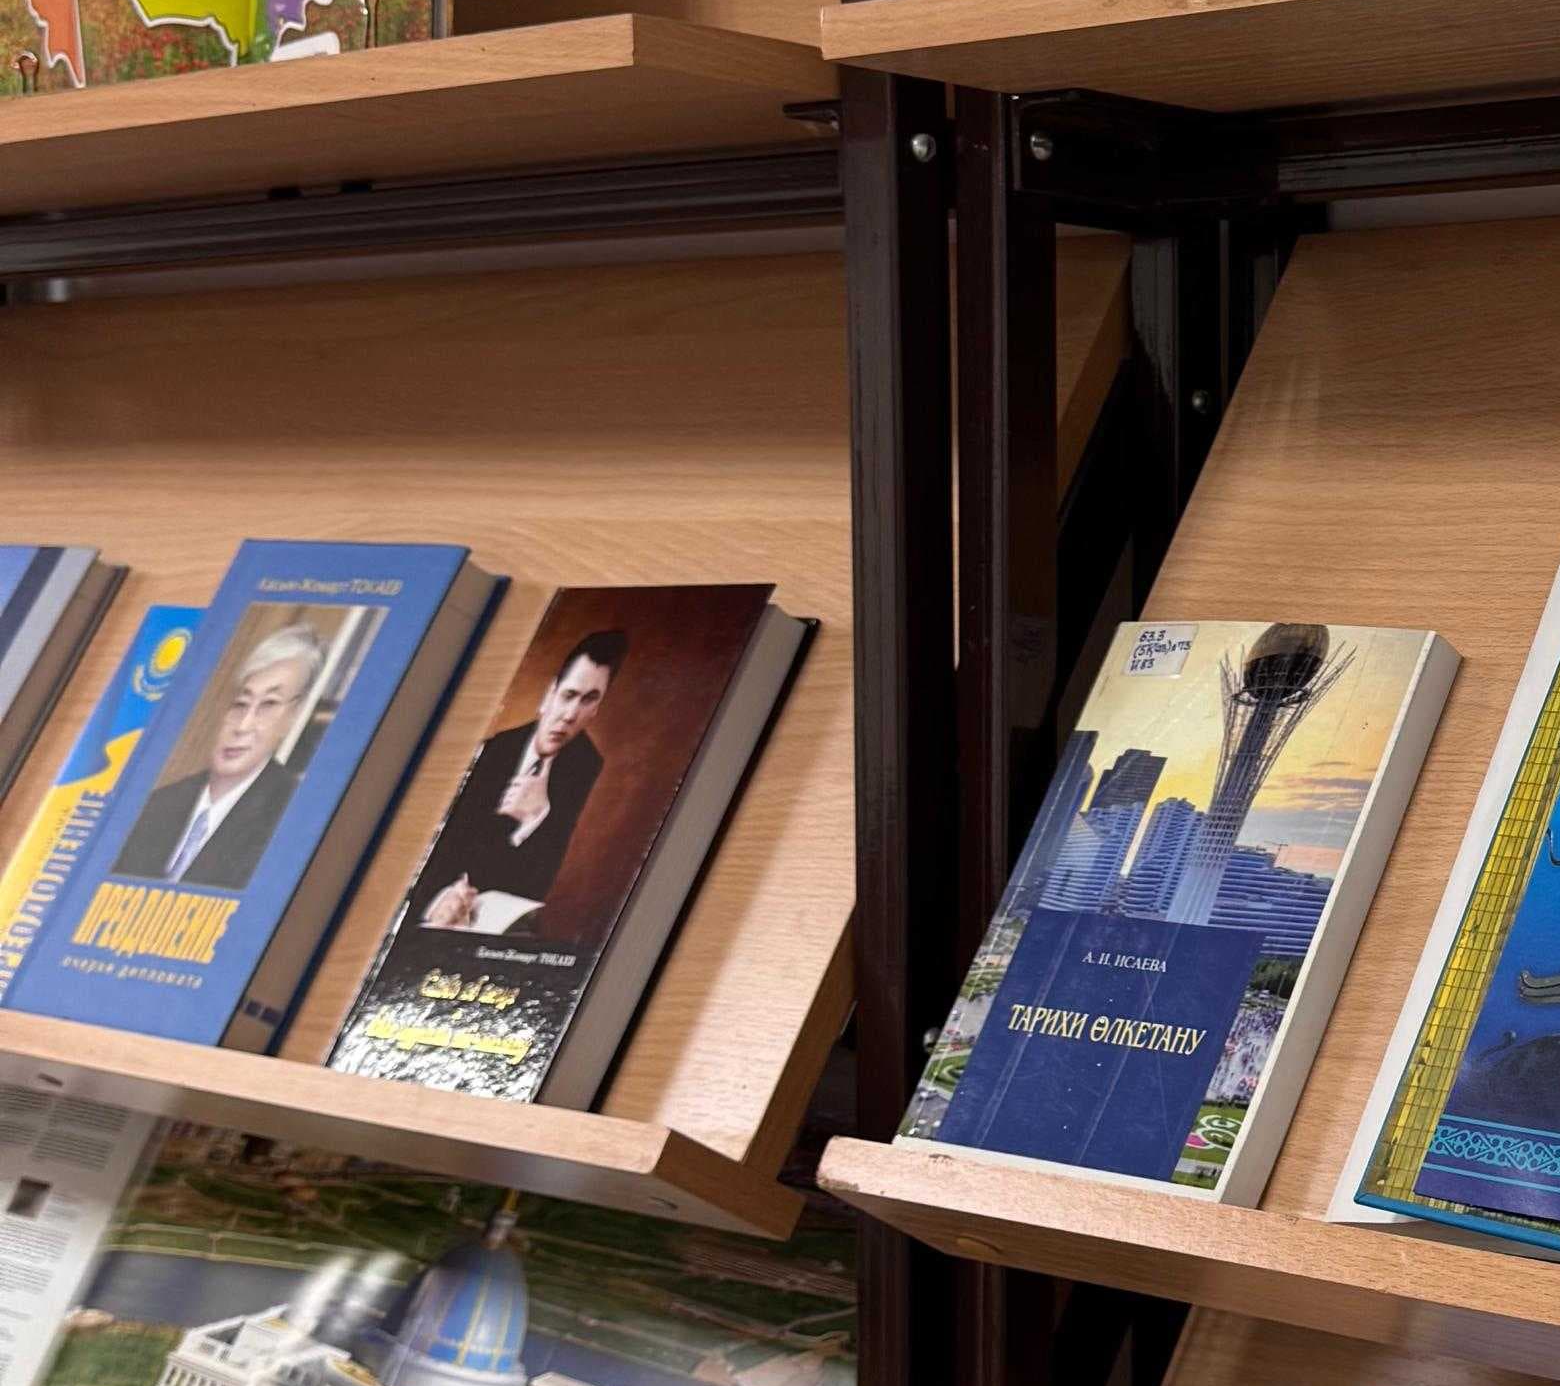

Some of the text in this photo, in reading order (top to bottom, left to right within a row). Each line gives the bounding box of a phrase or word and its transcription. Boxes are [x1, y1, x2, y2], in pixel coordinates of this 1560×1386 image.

[72, 881, 240, 965] ПРЕОДОЛЕНИЕ
[1112, 955, 1167, 973] ИСАЕВА
[1008, 1004, 1207, 1056] ТАРИХИ ӨЛКЕТАНУ
